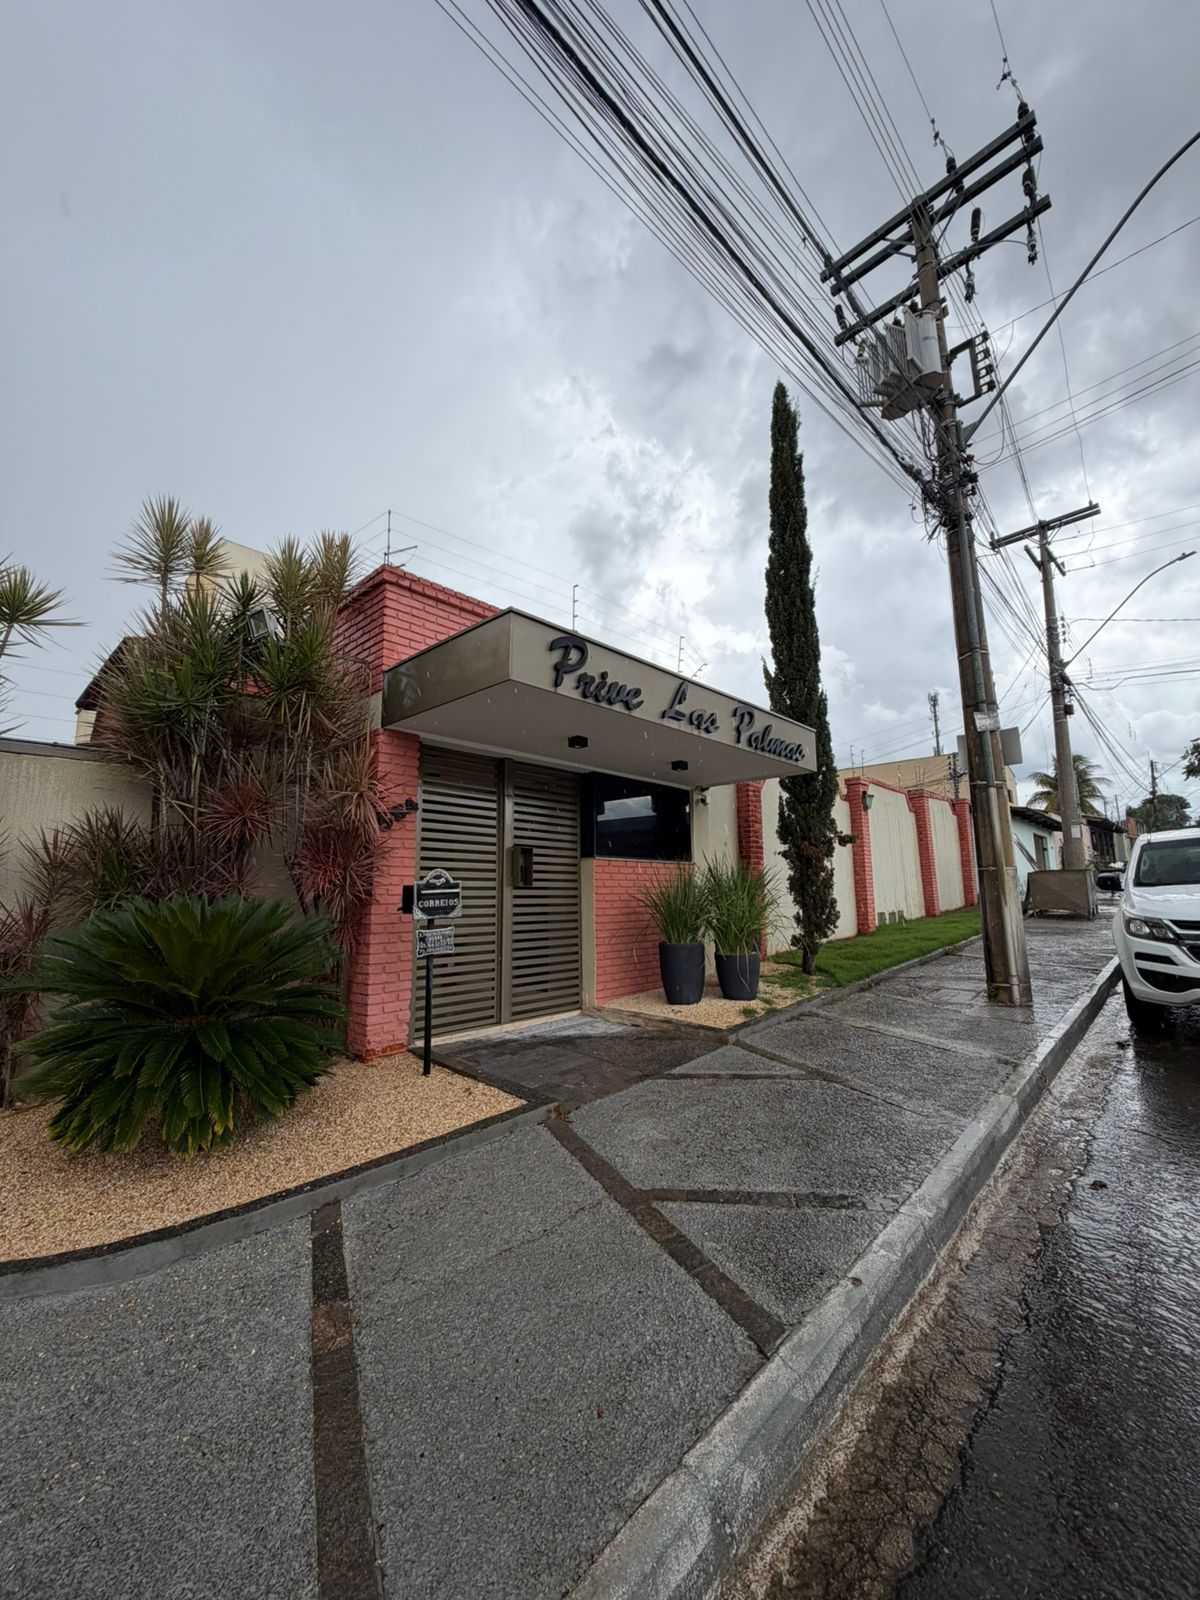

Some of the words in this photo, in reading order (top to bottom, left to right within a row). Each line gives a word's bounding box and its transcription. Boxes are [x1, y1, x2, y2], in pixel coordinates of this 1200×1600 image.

[549, 636, 644, 711] Prive
[661, 680, 720, 734] Las
[732, 706, 805, 762] Palmas
[418, 898, 459, 908] CORREIOS
